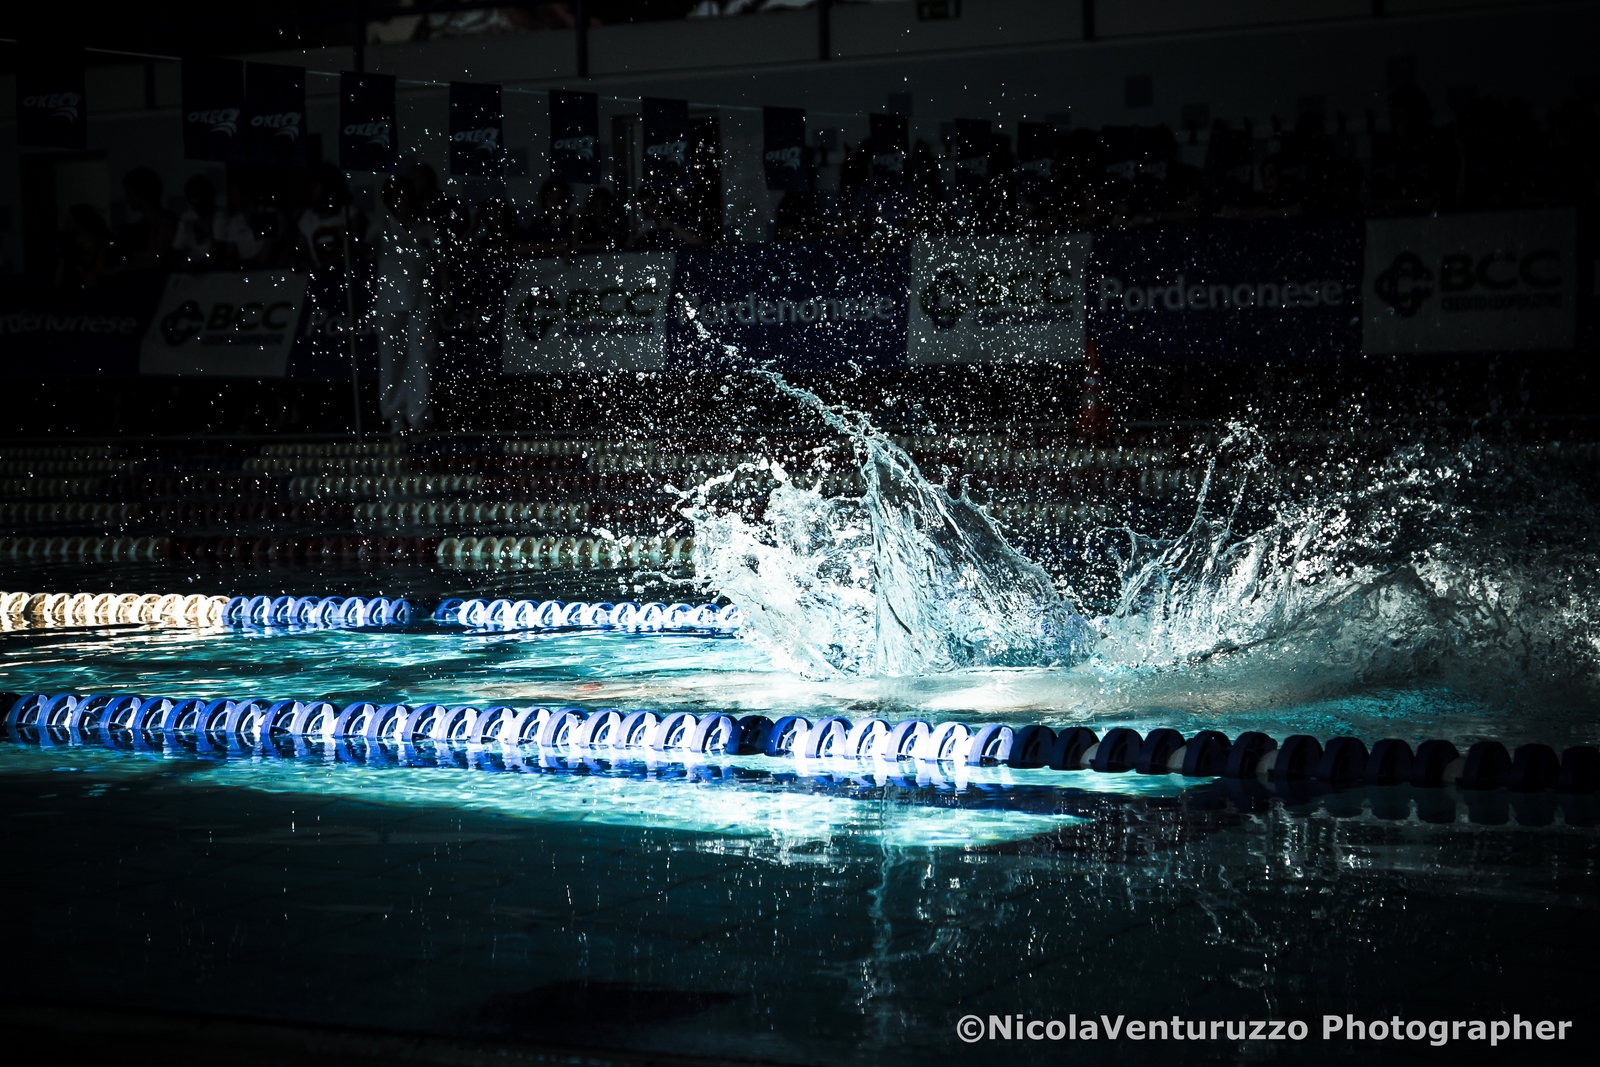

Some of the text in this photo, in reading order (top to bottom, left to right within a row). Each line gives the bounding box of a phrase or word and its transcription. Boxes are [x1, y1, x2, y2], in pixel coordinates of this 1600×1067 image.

[977, 270, 1073, 306] BCC
[1441, 249, 1562, 291] BCC
[564, 287, 658, 319] BCC
[1099, 274, 1344, 314] Pordenonese
[206, 301, 292, 330] BCC
